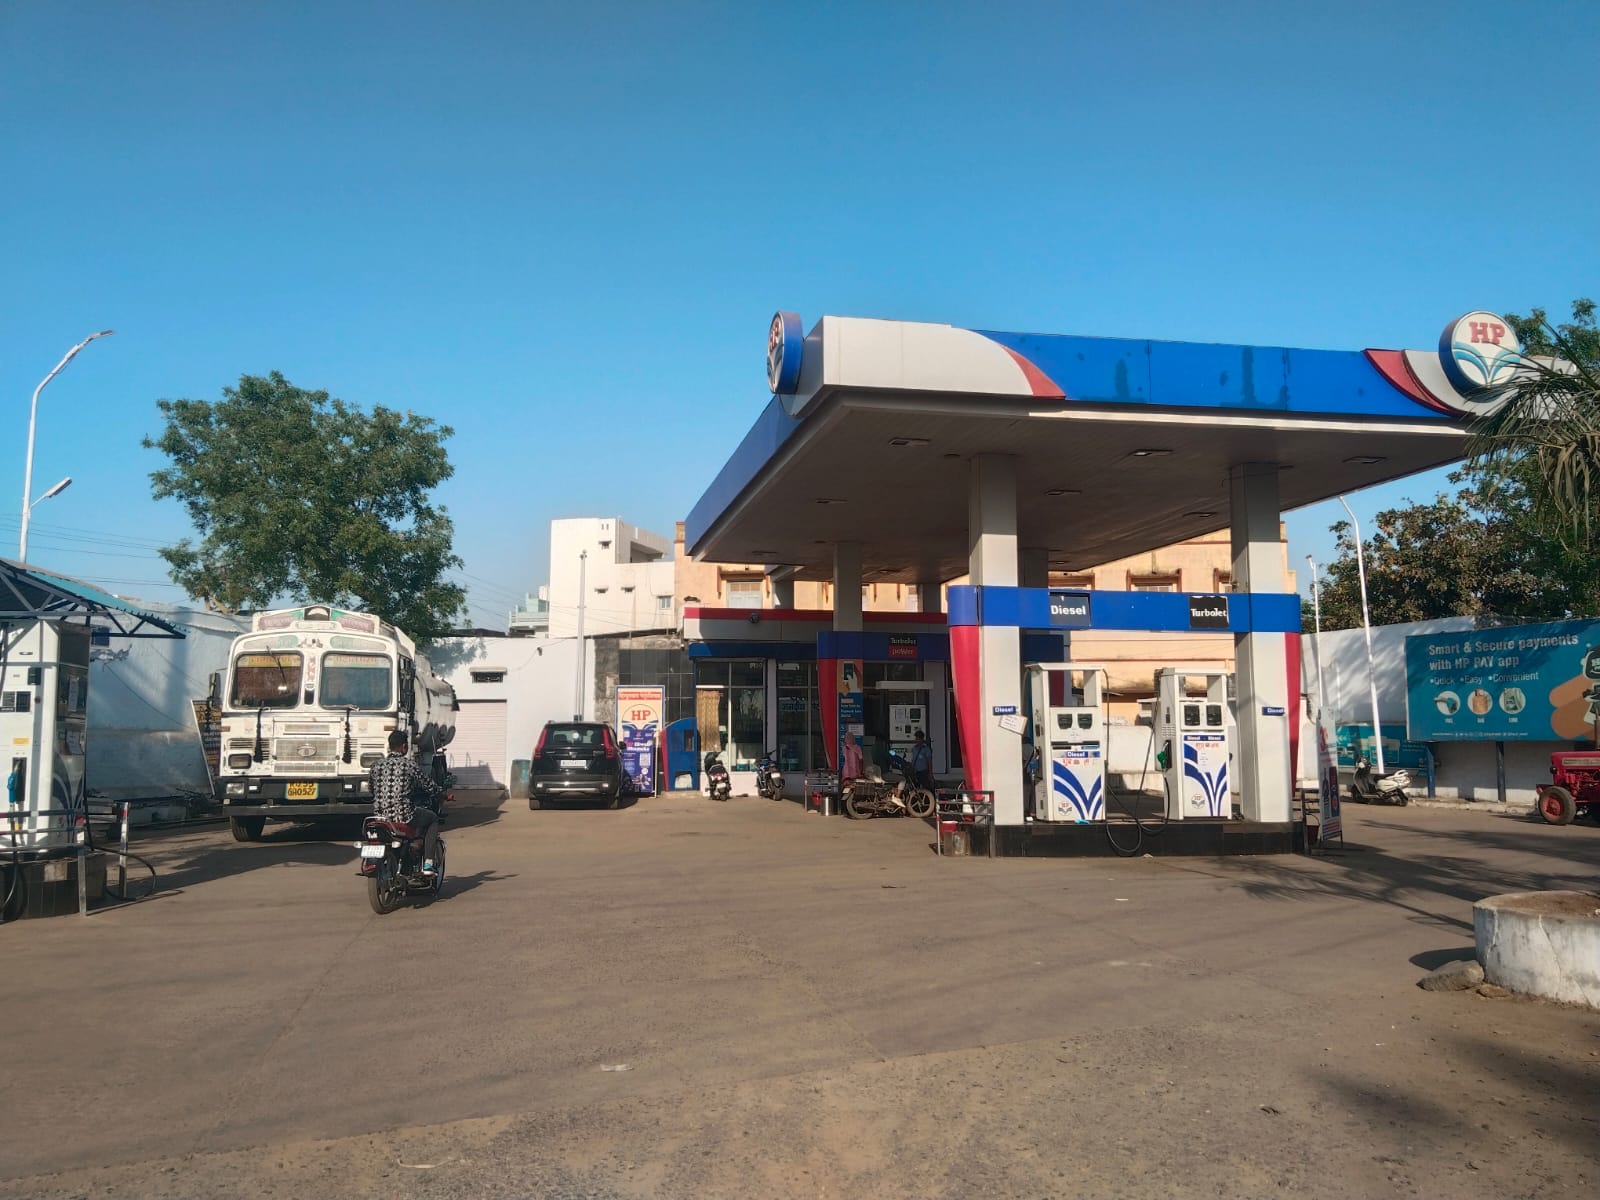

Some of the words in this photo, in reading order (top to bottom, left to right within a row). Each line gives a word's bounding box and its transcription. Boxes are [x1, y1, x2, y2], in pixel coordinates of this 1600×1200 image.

[1469, 322, 1505, 345] HP
[1051, 605, 1086, 615] Diesel
[1428, 644, 1460, 656] Smart
[1463, 642, 1472, 653] &
[1475, 640, 1515, 653] Secure
[1518, 634, 1579, 650] payments
[1429, 659, 1452, 671] with
[1455, 657, 1469, 669] HP
[1474, 656, 1494, 668] PAY
[1498, 656, 1519, 668] app
[1464, 675, 1483, 684] Easy
[1492, 671, 1539, 682] Convenient
[631, 710, 651, 720] HP
